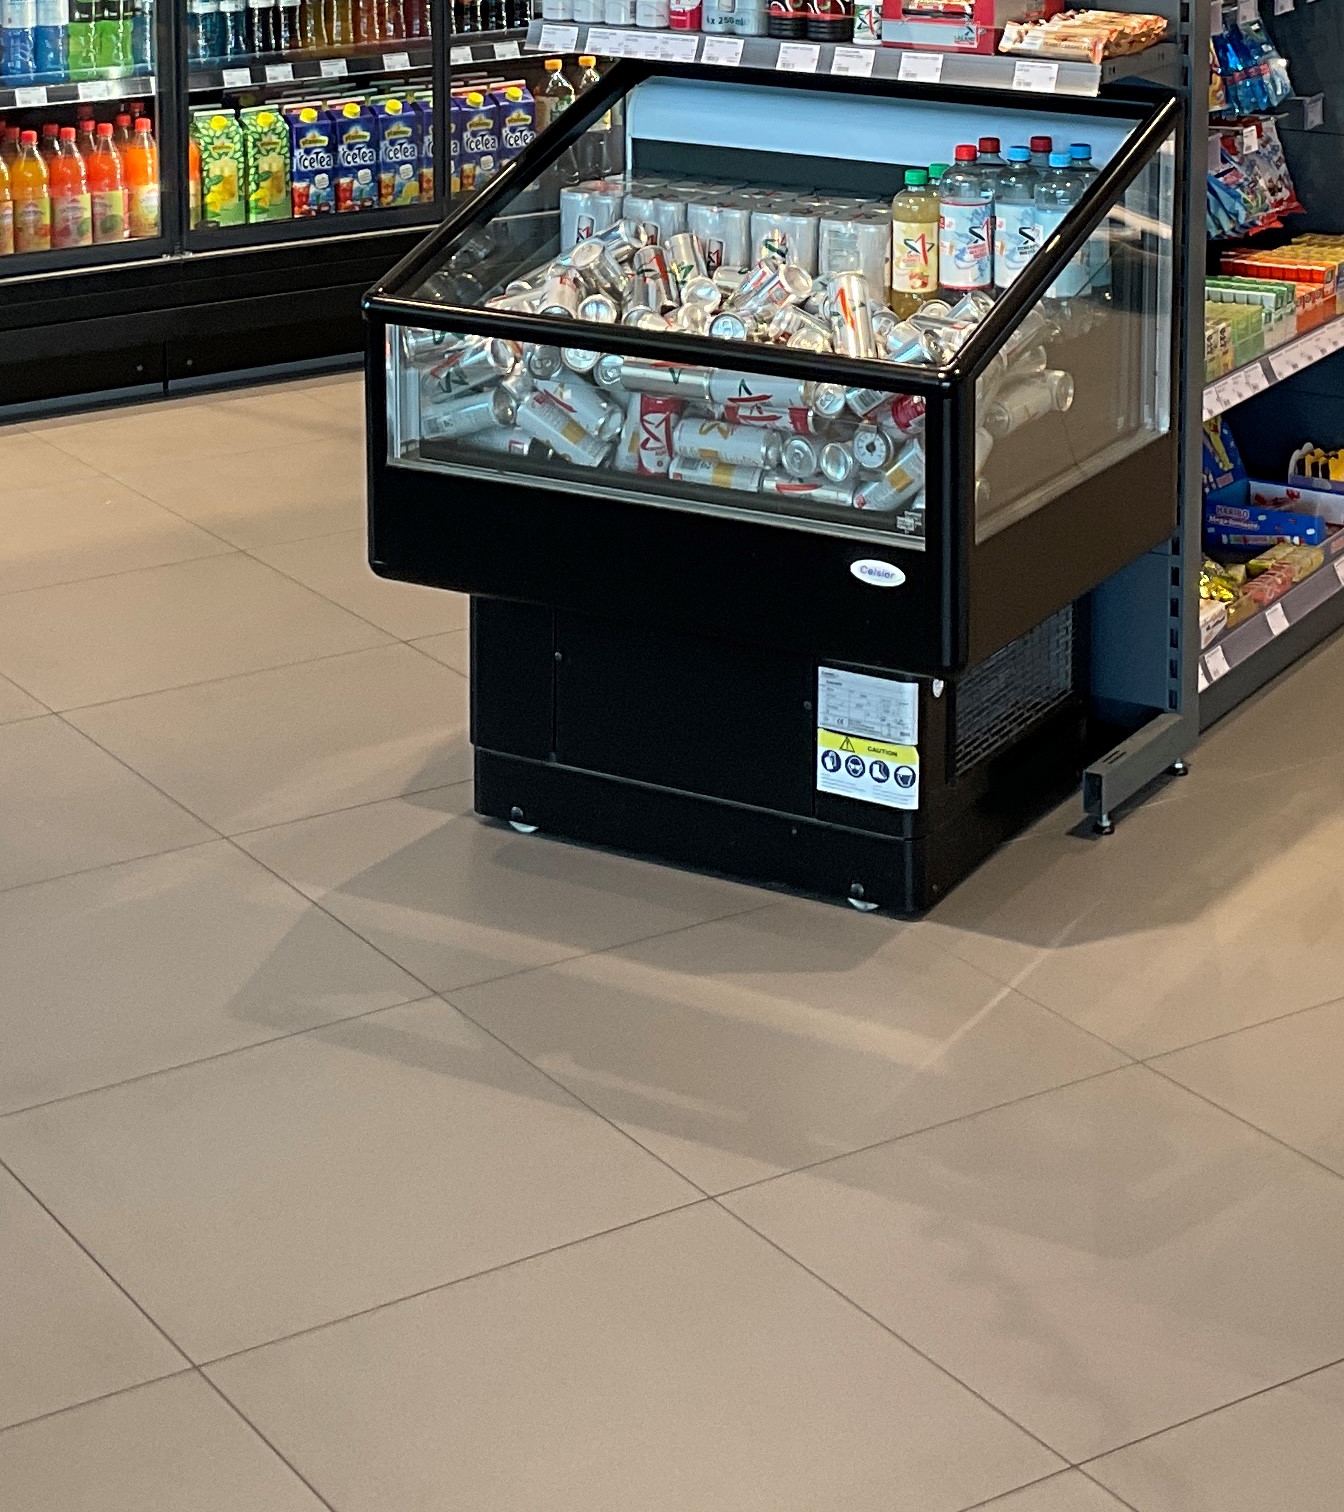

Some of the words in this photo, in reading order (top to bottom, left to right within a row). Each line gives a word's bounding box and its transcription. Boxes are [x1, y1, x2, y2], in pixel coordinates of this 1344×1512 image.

[1215, 505, 1250, 519] HARIBO
[859, 565, 895, 579] Celsior
[867, 746, 898, 757] CAUTION
